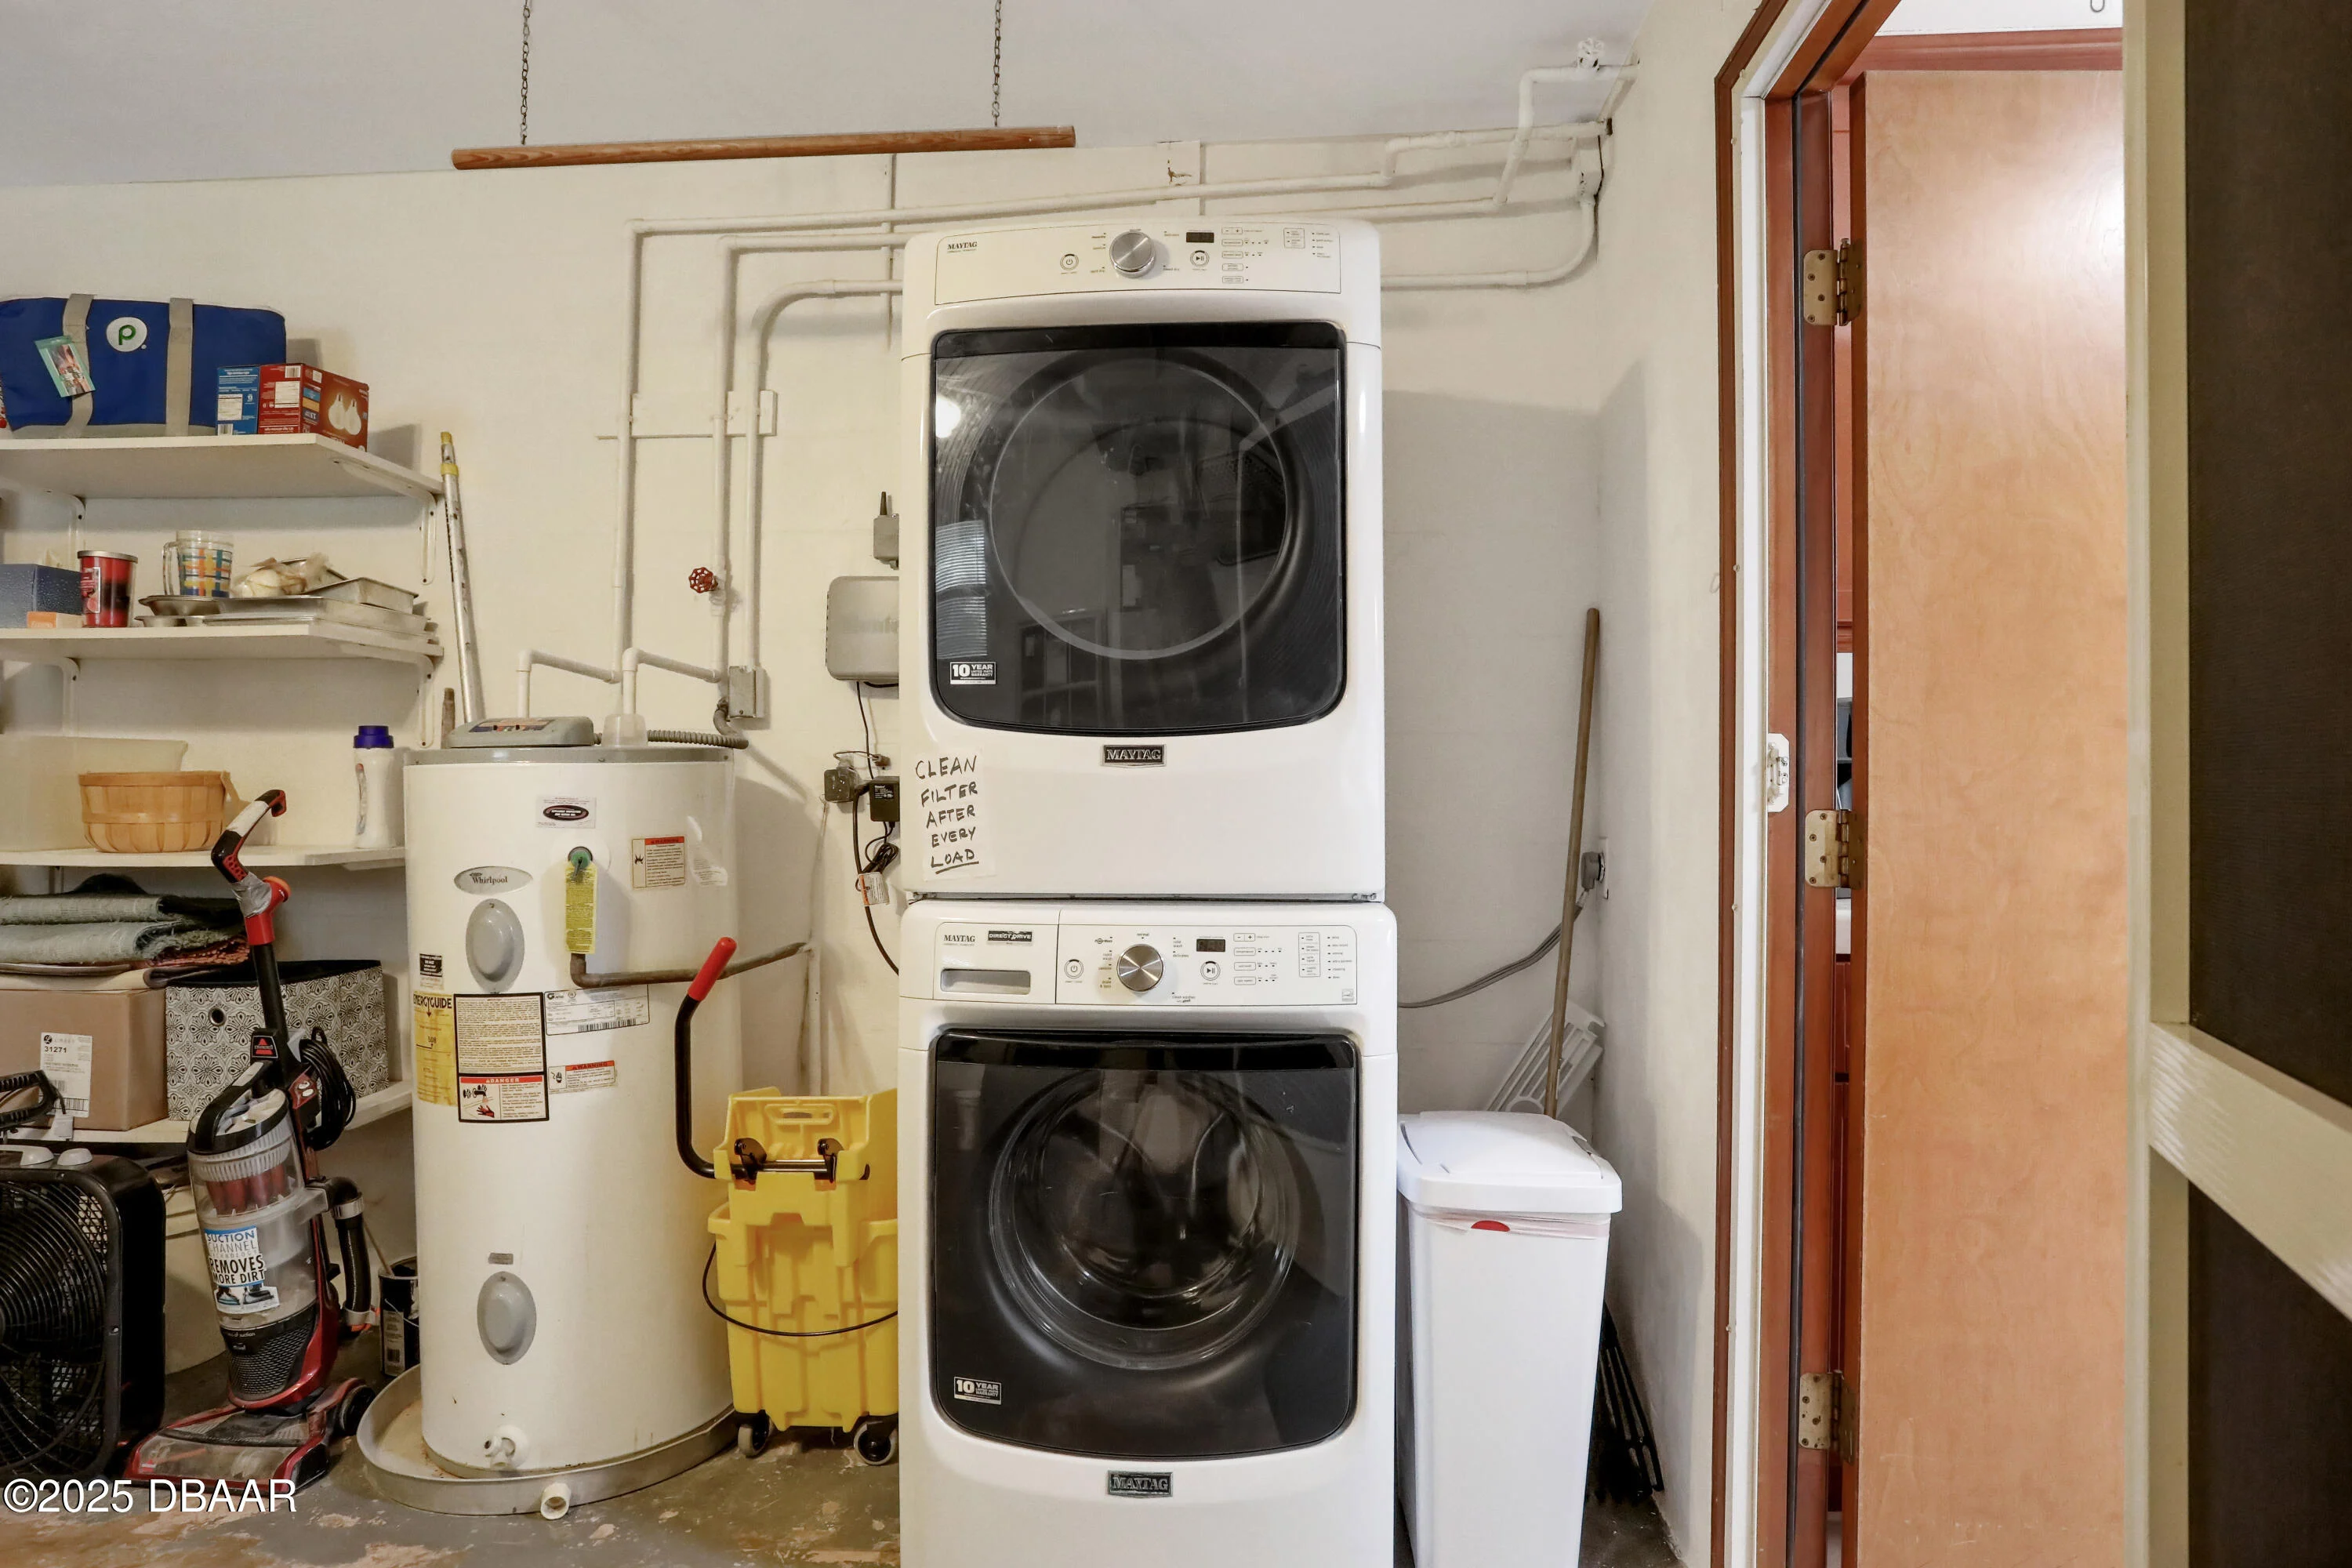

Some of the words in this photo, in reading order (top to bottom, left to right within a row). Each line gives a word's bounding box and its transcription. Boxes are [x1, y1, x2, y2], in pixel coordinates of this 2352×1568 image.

[947, 241, 978, 250] MAYTAG
[952, 664, 971, 677] 10
[1106, 749, 1162, 760] MAYTAG
[915, 755, 977, 779] CLEAN
[920, 781, 978, 808] FILTER
[926, 804, 976, 829] AFTER
[931, 826, 976, 848] EVERY
[931, 848, 975, 868] LOAD
[472, 876, 508, 885] Whirlpool
[207, 1230, 255, 1243] SUCTION
[207, 1240, 258, 1254] CHANNEL
[209, 1254, 264, 1274] REMOVES
[212, 1272, 236, 1284] MORE
[240, 1269, 264, 1283] DIRT
[956, 1379, 975, 1394] 10
[975, 1381, 999, 1390] YEAR
[1112, 1476, 1168, 1490] MAYTAG
